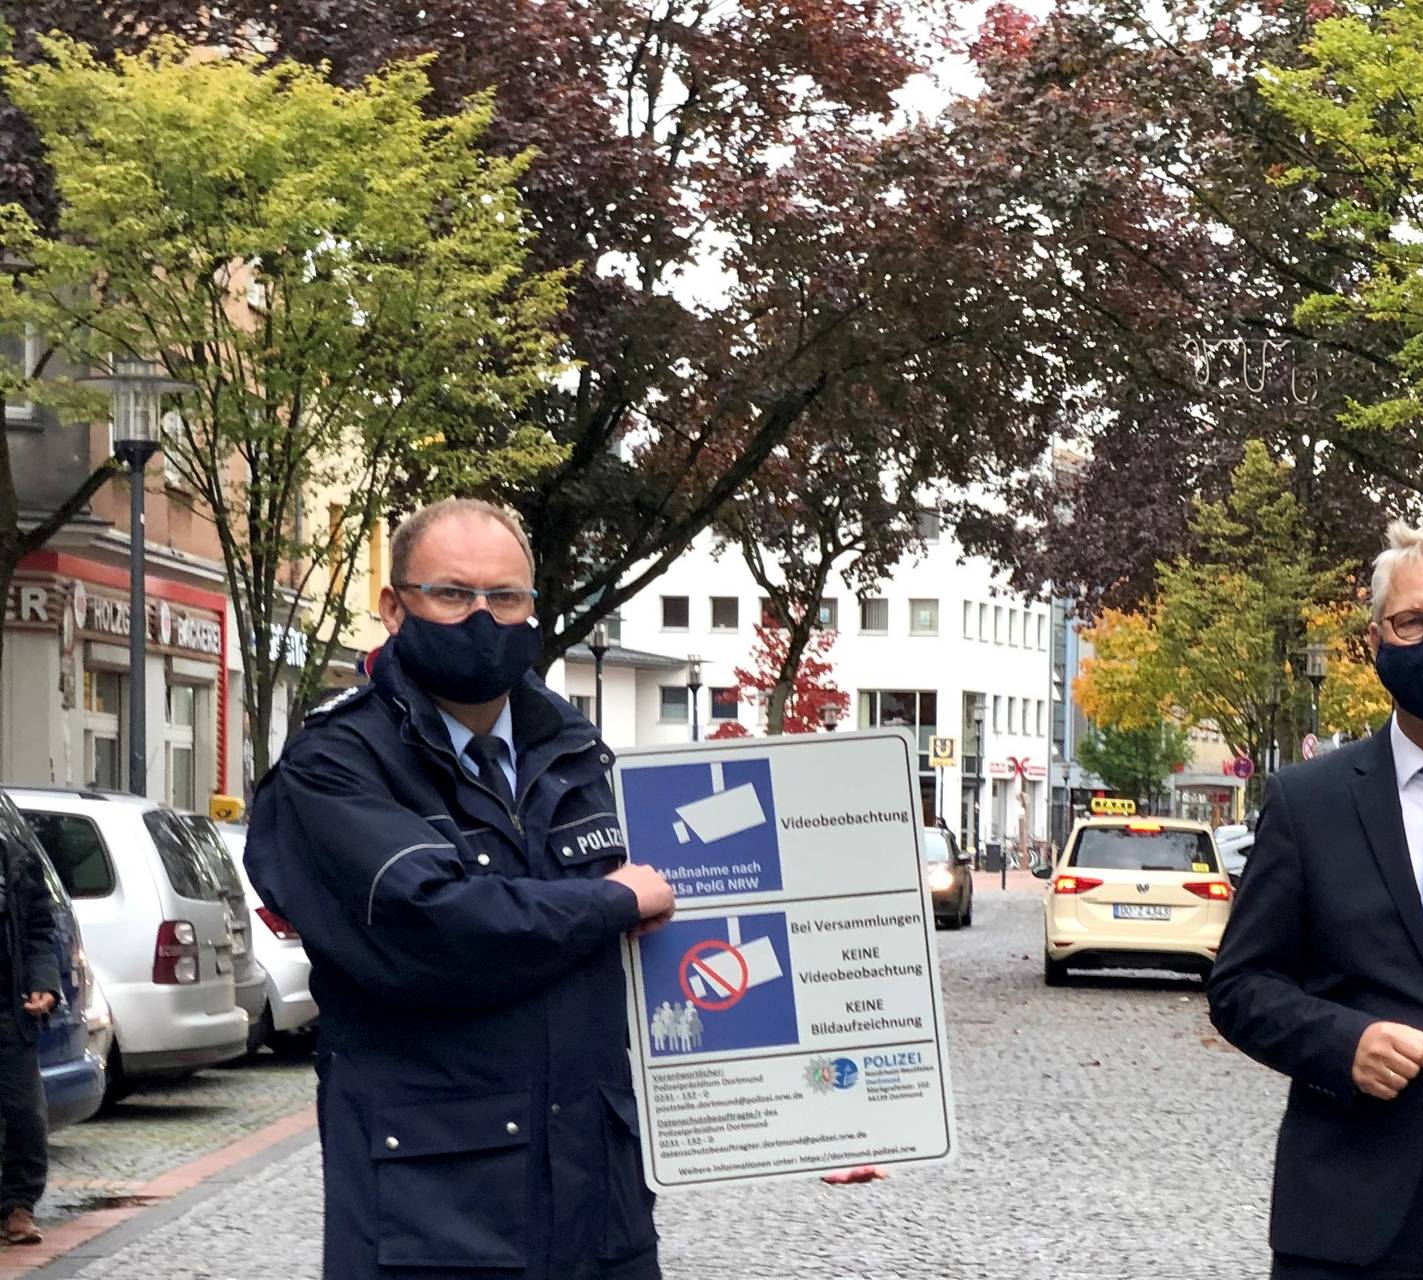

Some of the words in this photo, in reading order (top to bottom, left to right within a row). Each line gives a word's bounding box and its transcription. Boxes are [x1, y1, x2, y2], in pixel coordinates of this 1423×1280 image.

[781, 810, 909, 830] Videobeobachtung
[658, 864, 729, 880] Maßnahme
[732, 860, 761, 875] nach
[696, 880, 724, 894] PolG
[728, 876, 759, 890] NRW
[791, 921, 811, 934] Bei
[814, 914, 921, 932] Versammlungen
[842, 947, 880, 961] KEINE
[799, 964, 922, 984] Videobeobachtung
[845, 998, 884, 1013] KEINE
[810, 1016, 922, 1035] Bildaufzeichnung
[863, 1051, 922, 1069] POLIZEI
[721, 1074, 764, 1086] Dortmund
[764, 1108, 778, 1117] des
[727, 1119, 768, 1130] Dortmund
[678, 1165, 711, 1176] Weitere
[713, 1160, 772, 1173] Informationen
